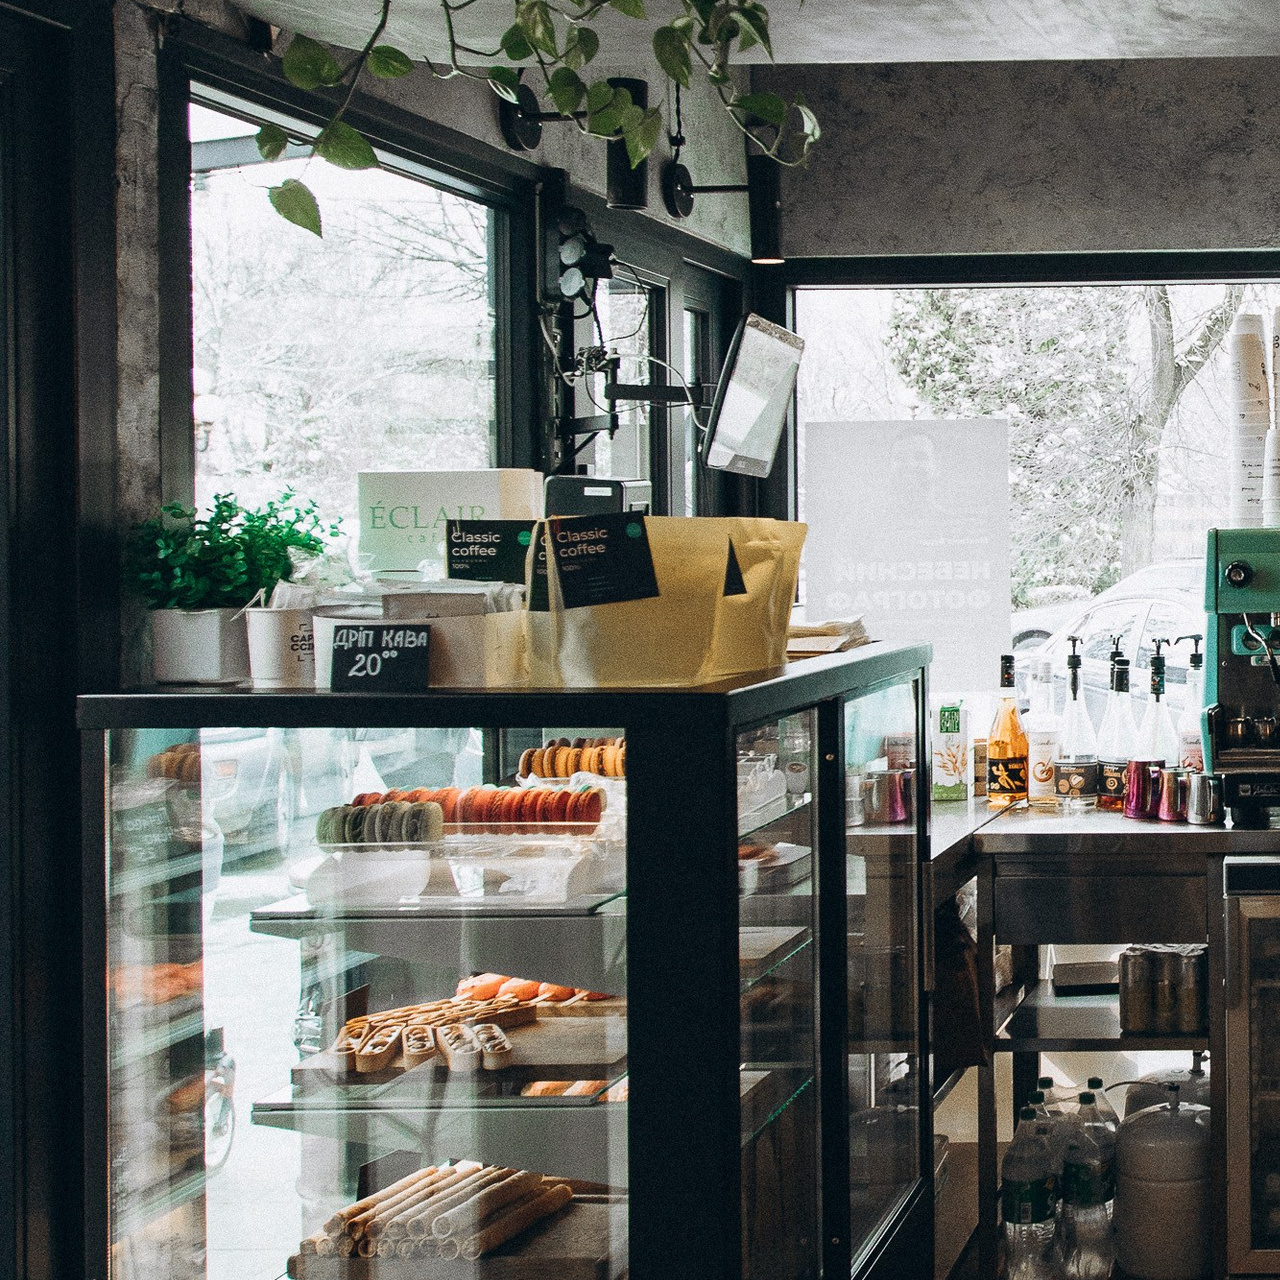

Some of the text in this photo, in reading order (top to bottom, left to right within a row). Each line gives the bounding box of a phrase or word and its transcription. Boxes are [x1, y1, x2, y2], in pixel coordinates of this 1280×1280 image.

[369, 500, 486, 530] ÉCLAIR
[407, 532, 438, 544] caf
[451, 531, 501, 543] Classic
[556, 527, 608, 543] Classic
[451, 545, 497, 556] coffee
[559, 543, 606, 558] coffee
[290, 634, 314, 643] CAP
[381, 629, 428, 648] КАВА
[290, 643, 314, 651] CCI
